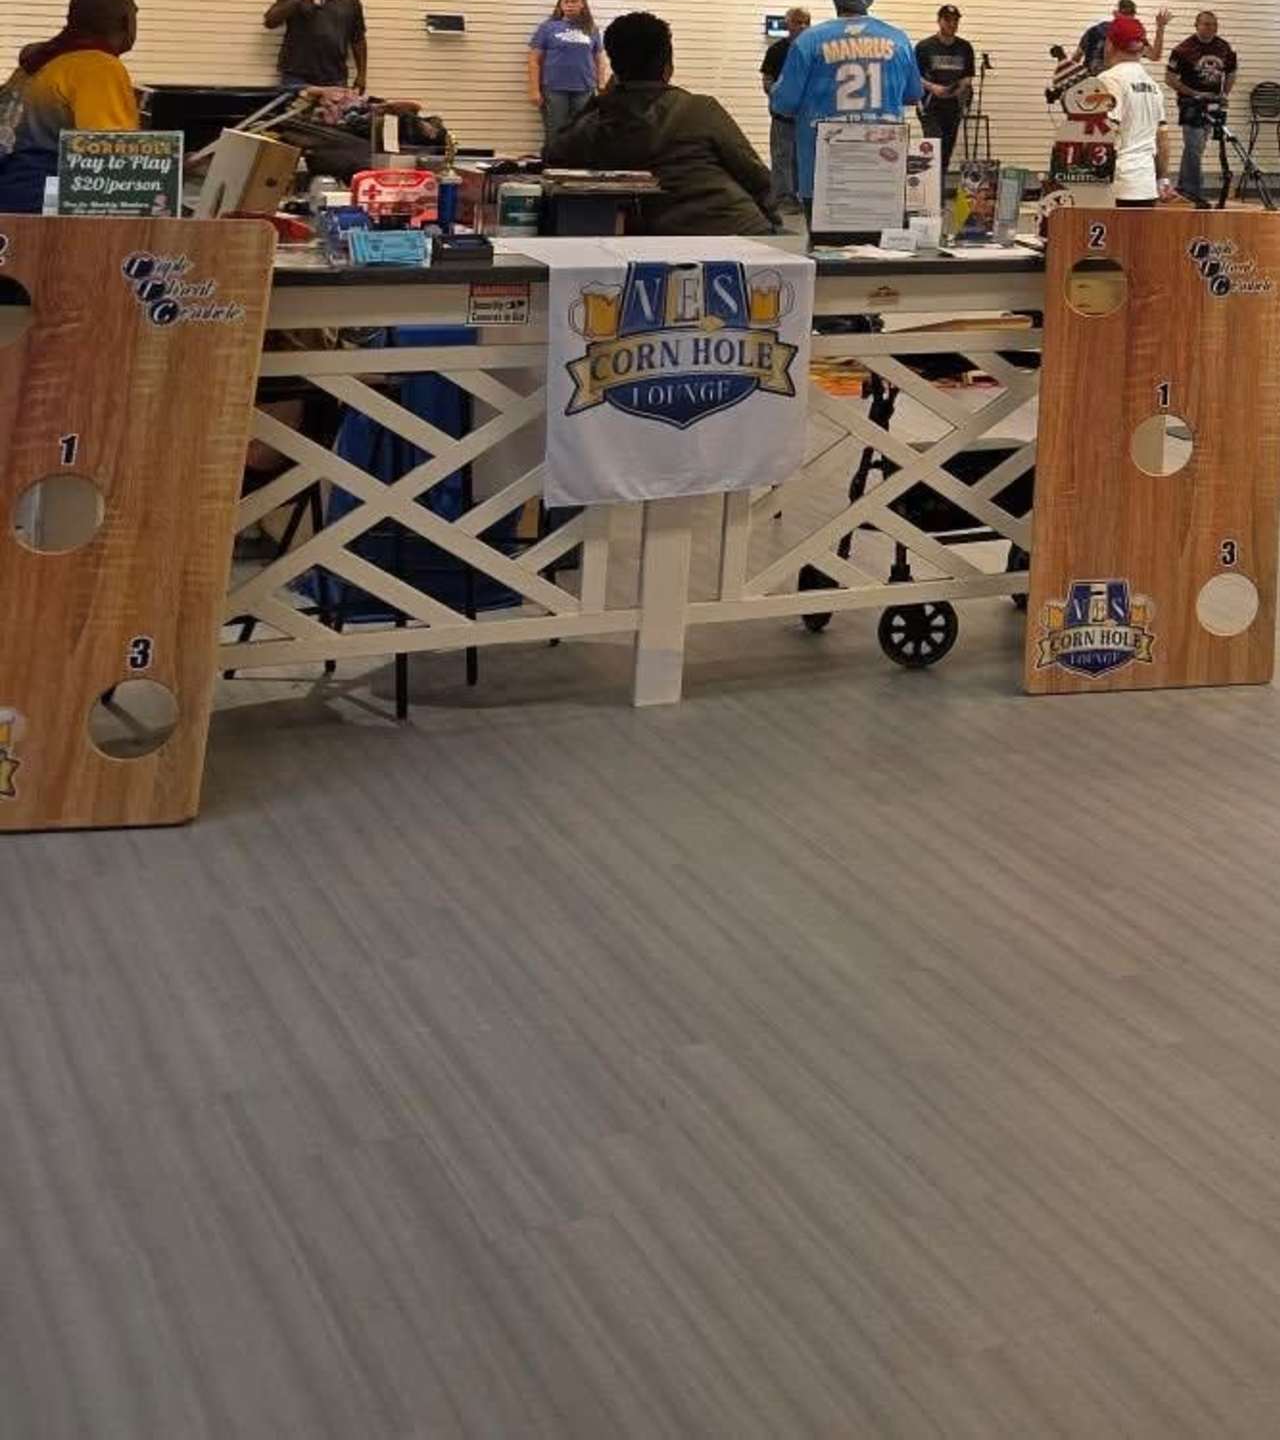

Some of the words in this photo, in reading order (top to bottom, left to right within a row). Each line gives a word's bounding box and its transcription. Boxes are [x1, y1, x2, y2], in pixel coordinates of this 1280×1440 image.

[835, 61, 883, 112] 21
[66, 153, 105, 174] Pay
[107, 154, 127, 171] to
[131, 153, 172, 174] Play
[70, 174, 162, 195] $20/person
[1089, 224, 1106, 248] 2
[633, 274, 740, 323] NES
[588, 339, 680, 381] CORN
[691, 337, 774, 370] HOLE
[631, 378, 733, 407] LOUNGE
[1157, 383, 1171, 406] 1
[61, 434, 78, 464] 1
[1222, 541, 1236, 564] 3
[130, 638, 151, 669] 3
[1049, 630, 1096, 652] CORN
